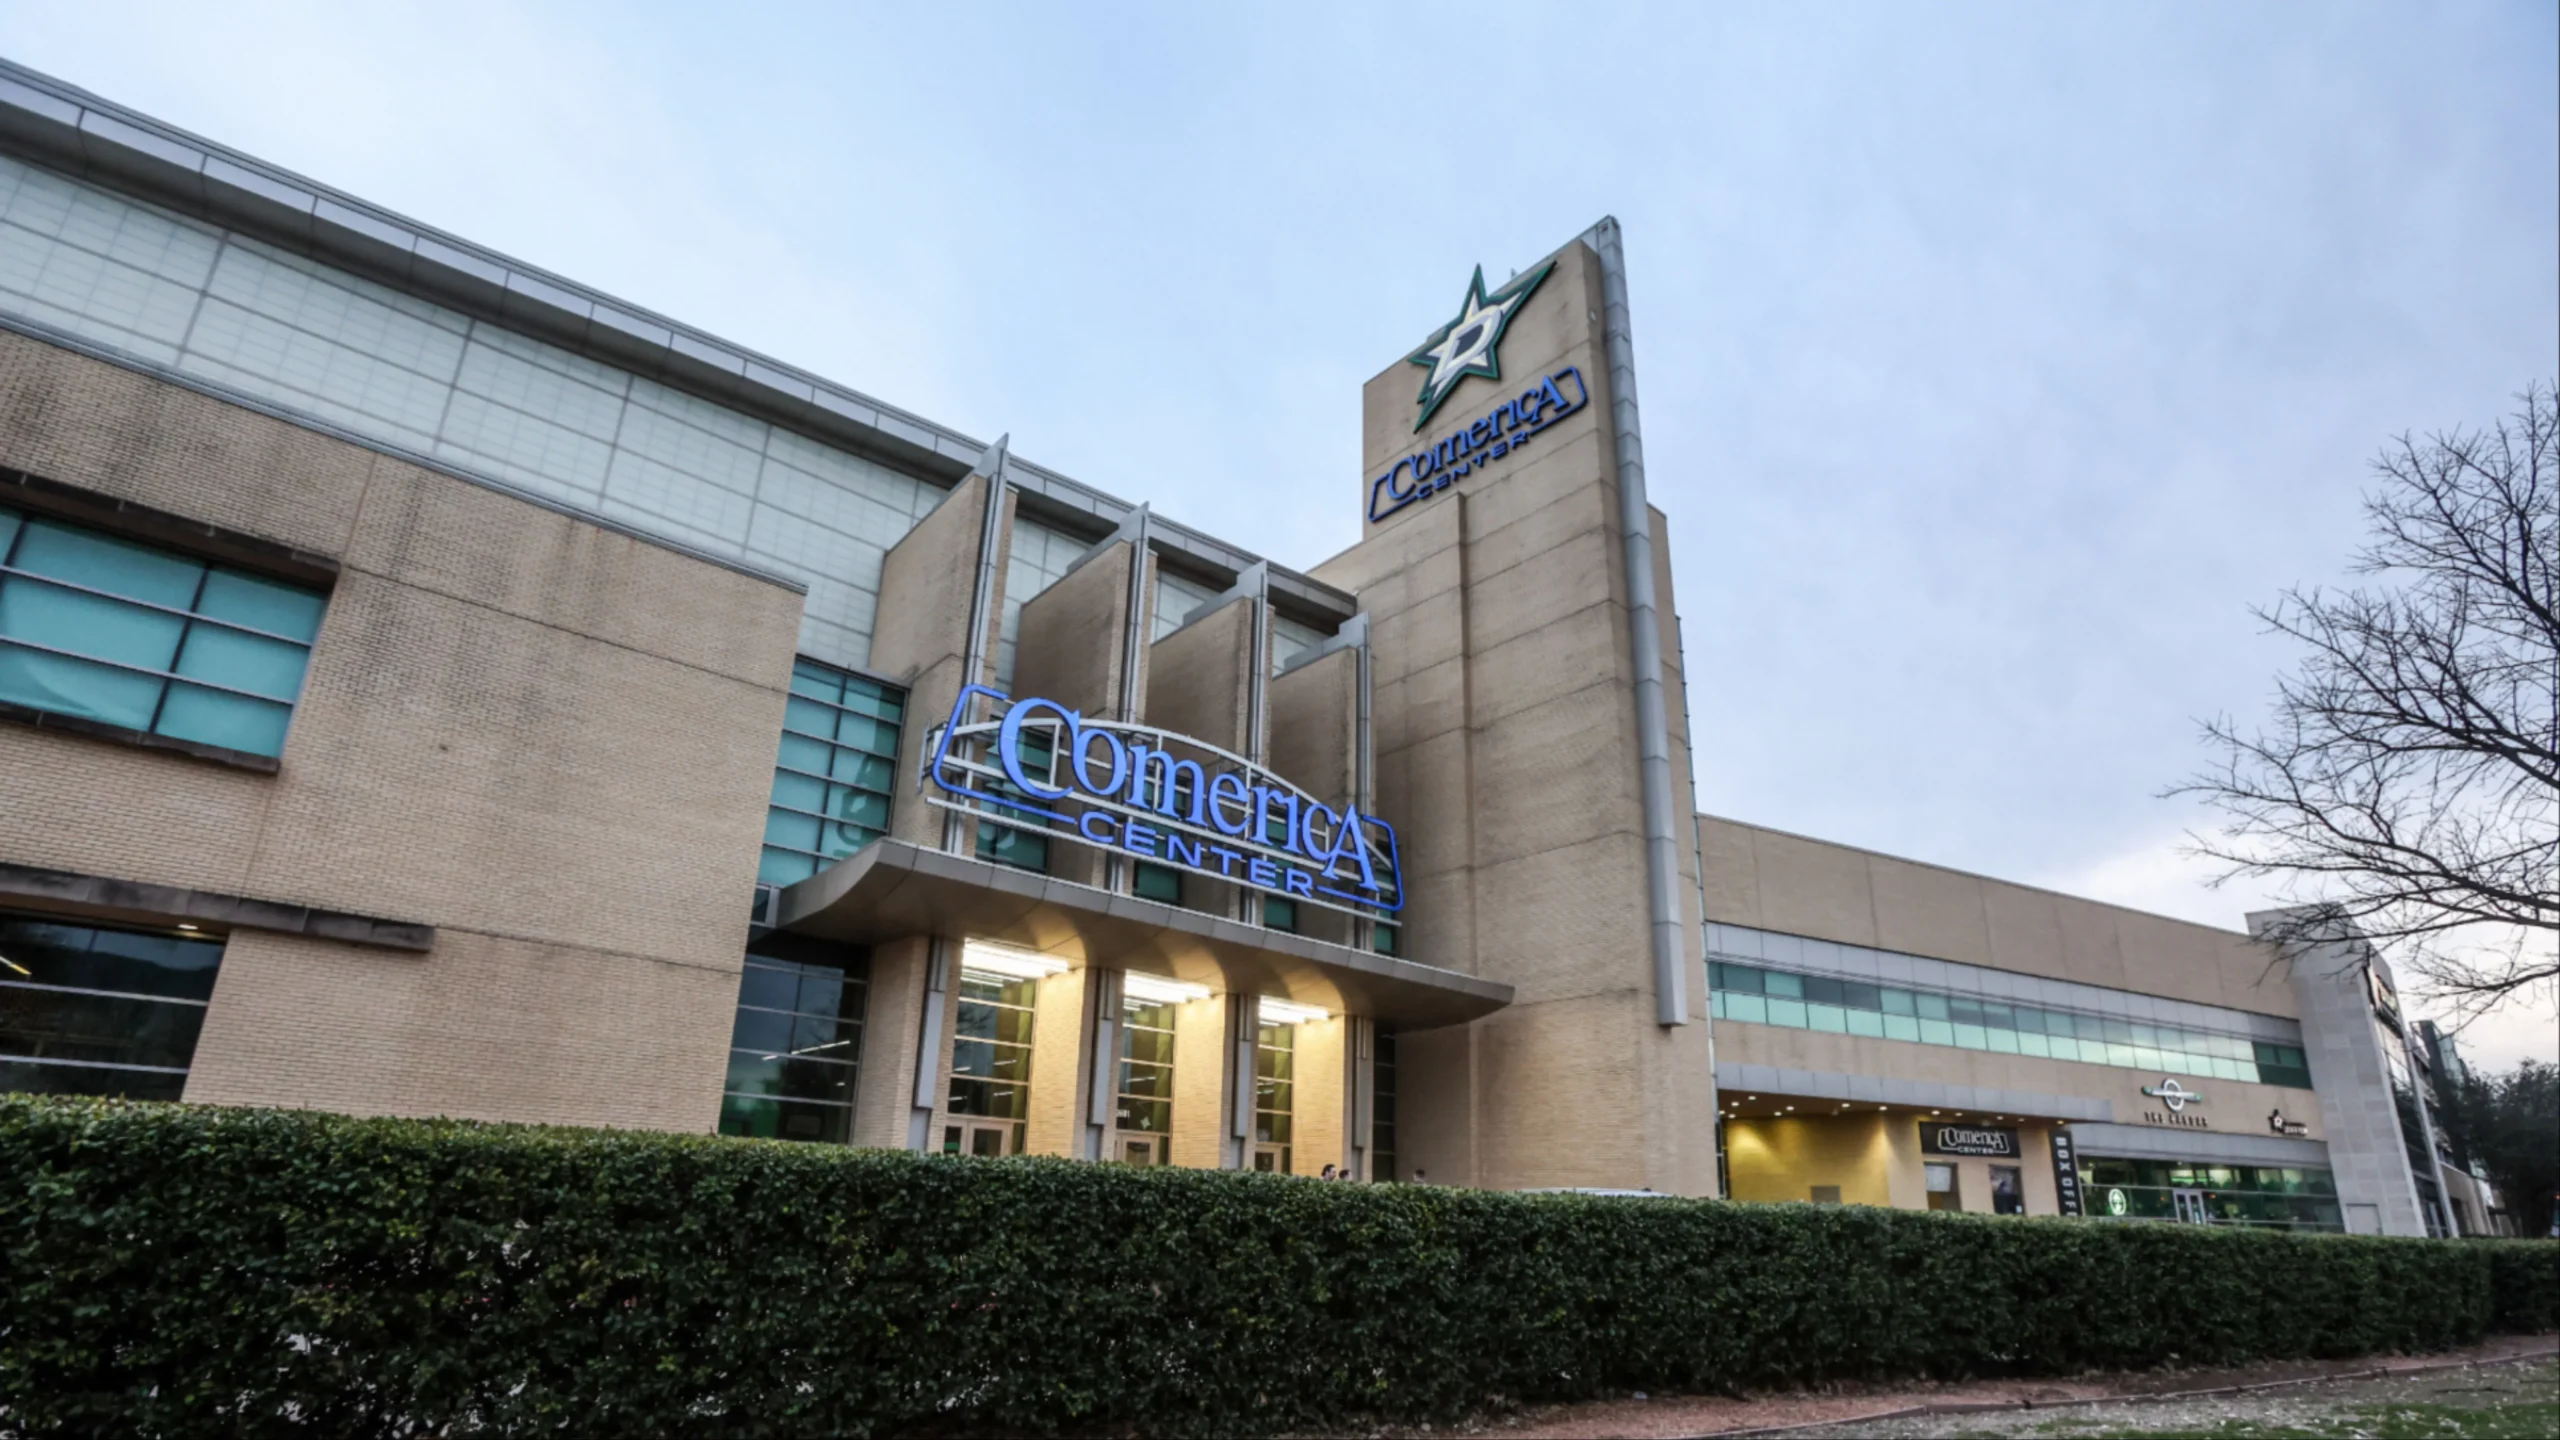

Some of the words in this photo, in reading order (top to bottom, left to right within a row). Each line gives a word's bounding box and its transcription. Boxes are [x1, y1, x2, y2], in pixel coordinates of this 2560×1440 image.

[1415, 431, 1531, 499] CENTER
[1078, 810, 1316, 898] CENTER
[1958, 1146, 1995, 1154] CENTER
[2055, 1136, 2071, 1171] BOX
